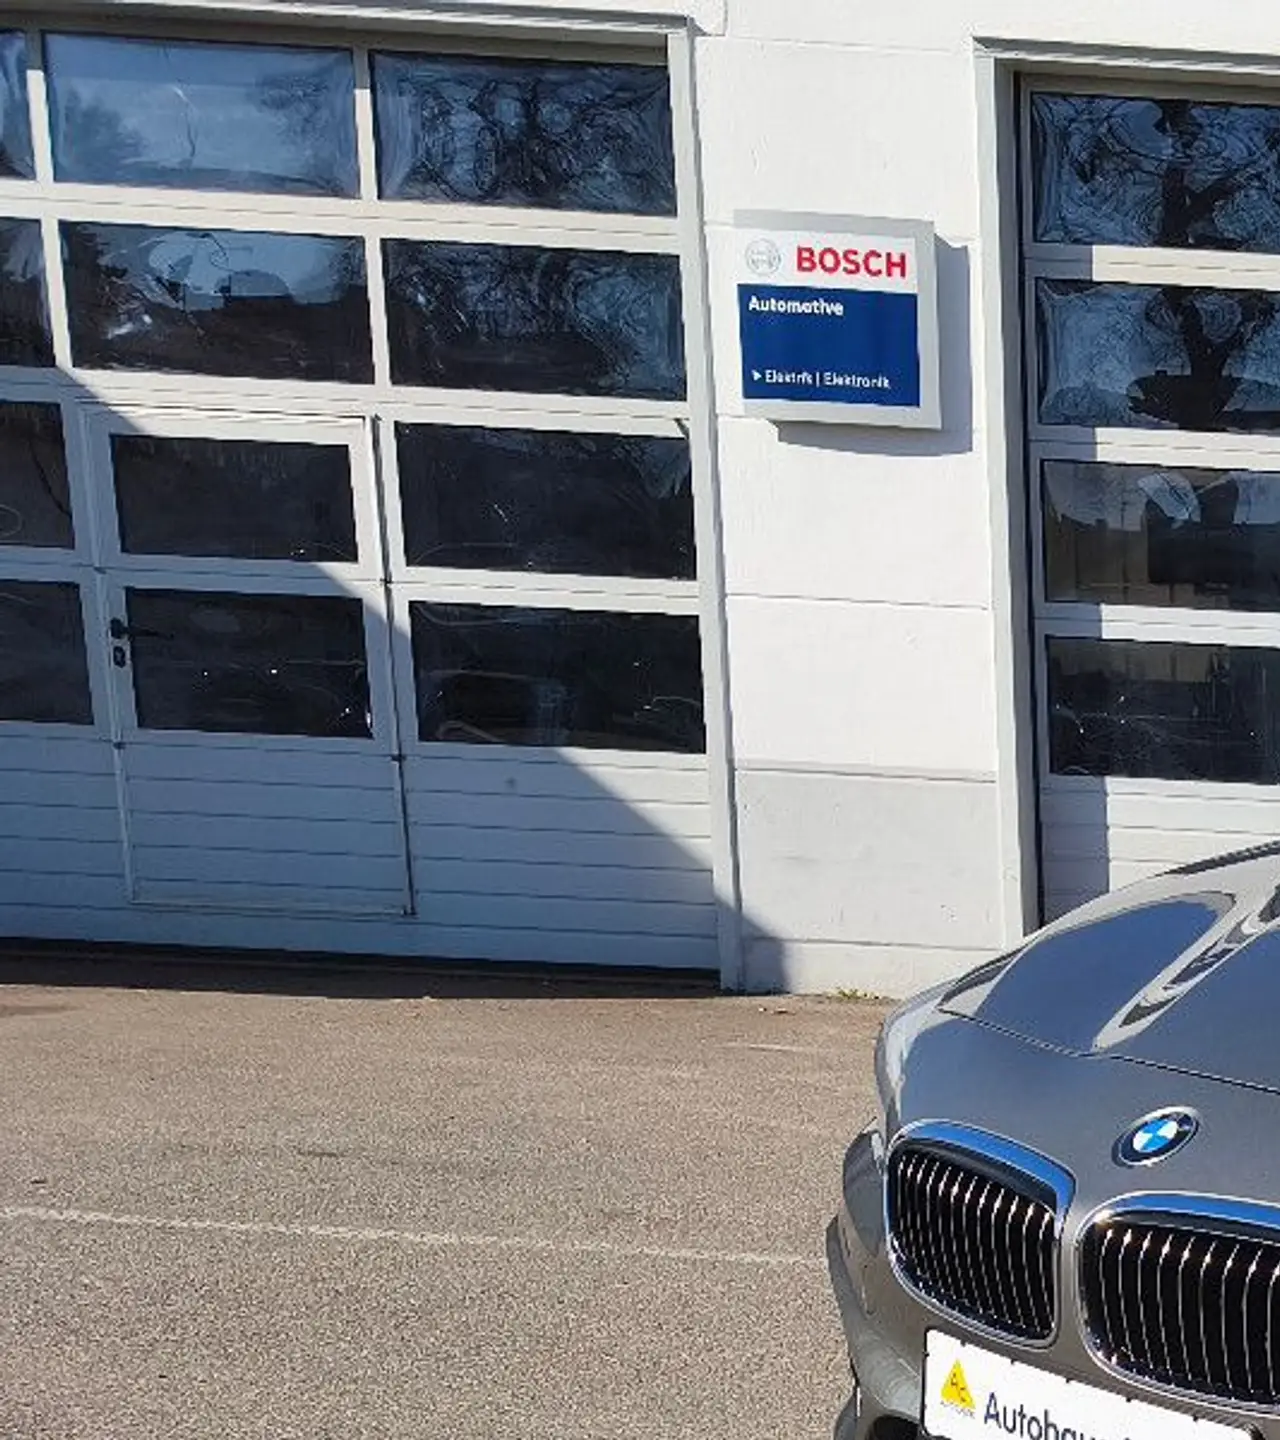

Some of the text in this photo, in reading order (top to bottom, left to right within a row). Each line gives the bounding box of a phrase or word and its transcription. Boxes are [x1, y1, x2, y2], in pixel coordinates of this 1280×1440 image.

[796, 246, 907, 278] BOSCH
[749, 296, 844, 316] Automotive
[765, 369, 891, 389] Elektrik Elektronik
